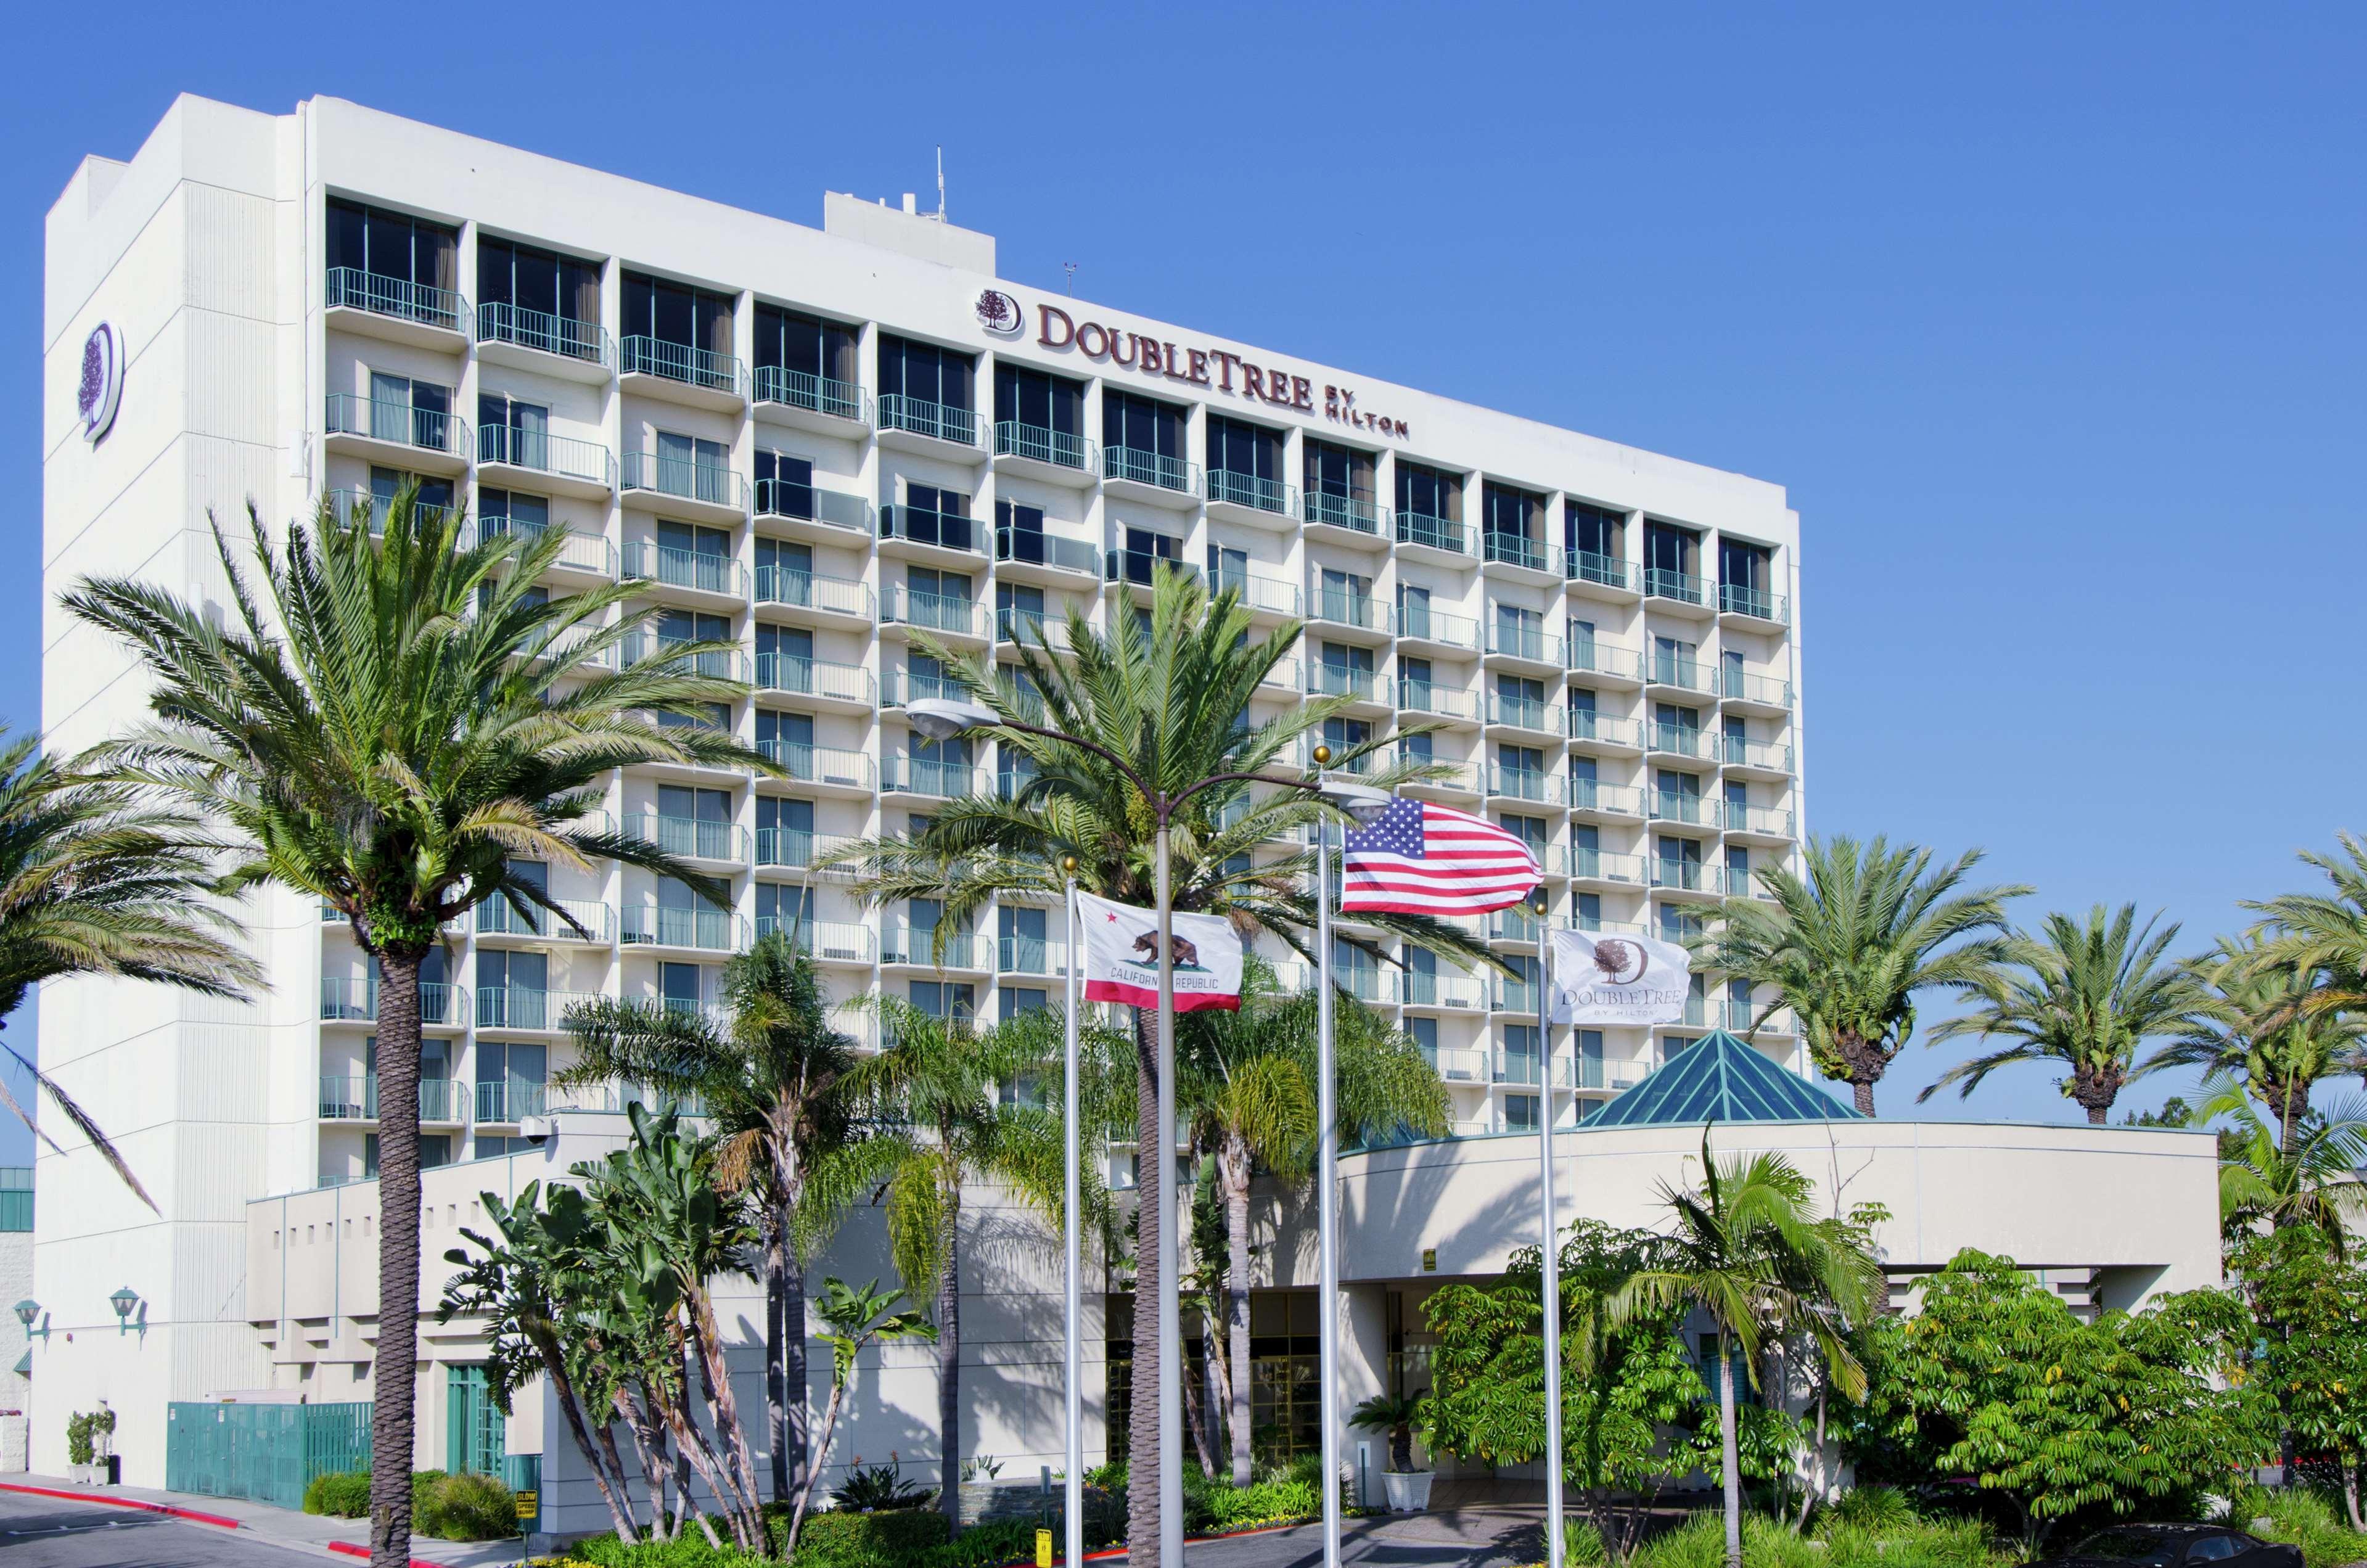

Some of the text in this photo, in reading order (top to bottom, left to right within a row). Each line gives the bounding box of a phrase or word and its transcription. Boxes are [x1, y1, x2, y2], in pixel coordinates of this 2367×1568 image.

[1037, 304, 1313, 410] DOUBLETREE
[1325, 385, 1355, 404] BY
[1324, 402, 1408, 435] HILTON
[1110, 967, 1218, 989] CALIFORN REPUBLIC
[1562, 988, 1681, 1006] DOUBLETREE
